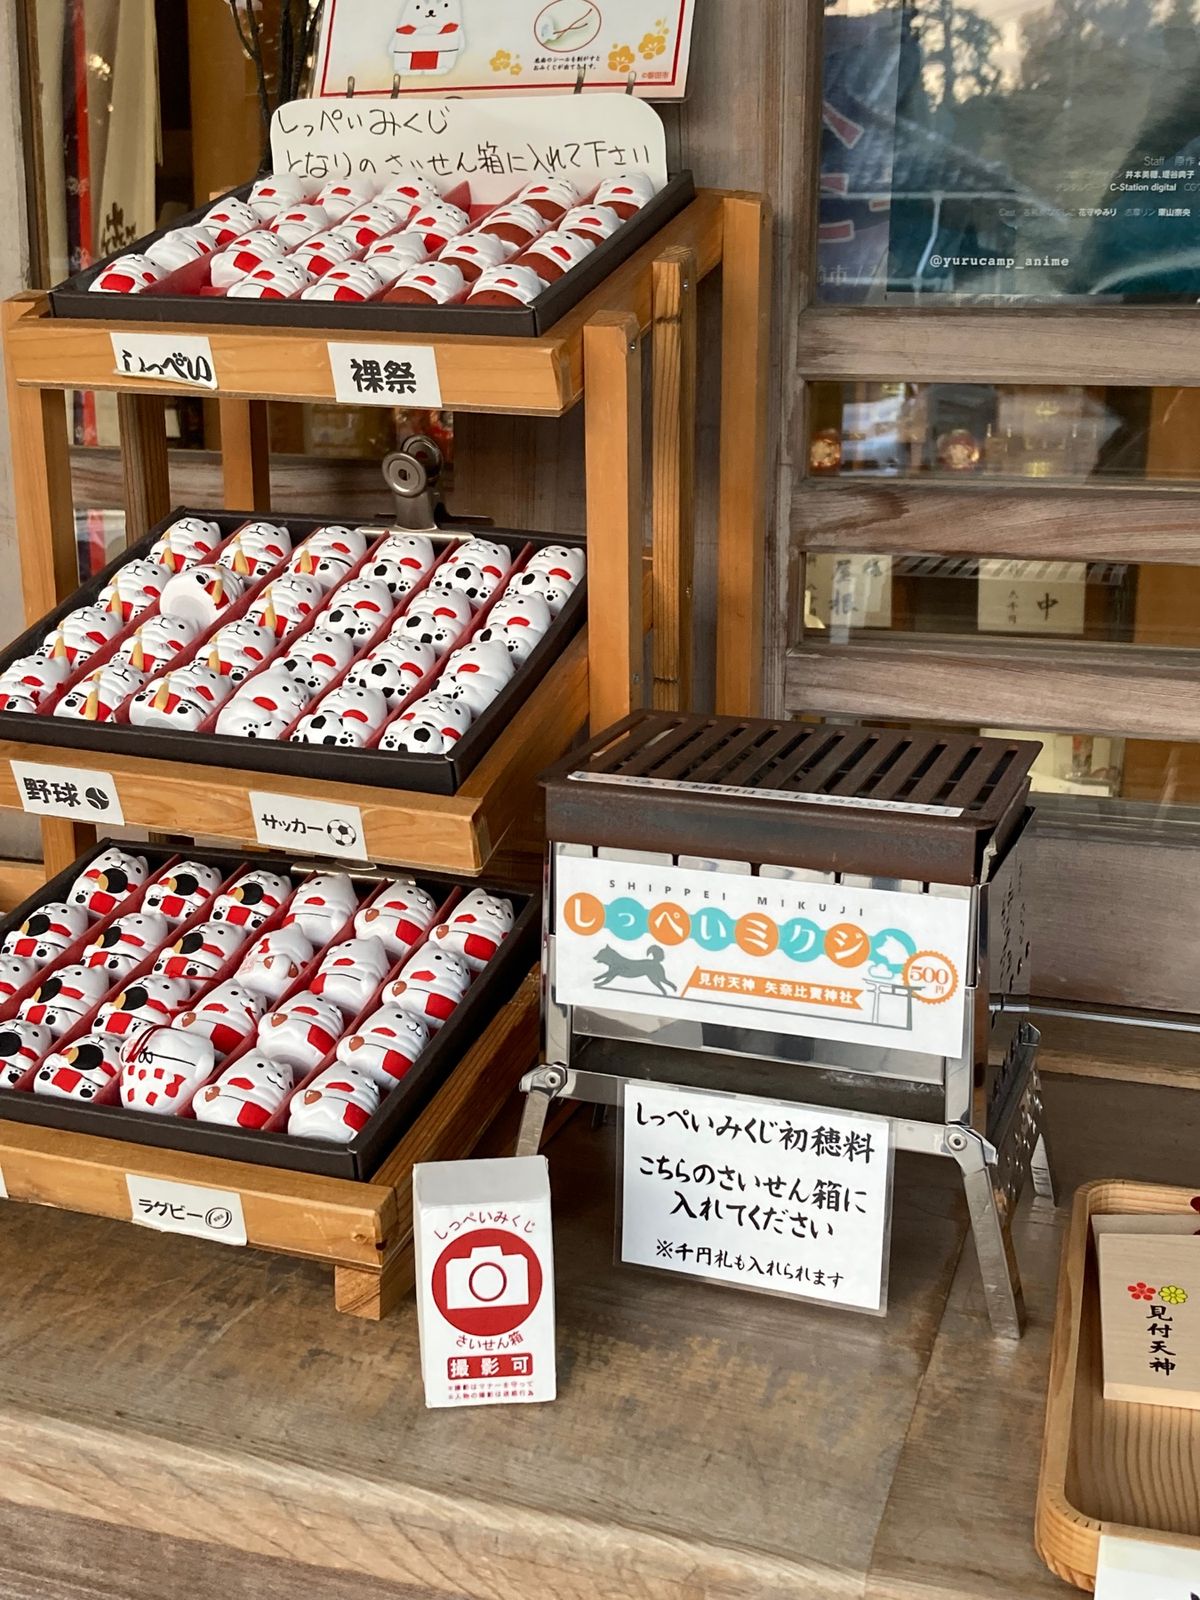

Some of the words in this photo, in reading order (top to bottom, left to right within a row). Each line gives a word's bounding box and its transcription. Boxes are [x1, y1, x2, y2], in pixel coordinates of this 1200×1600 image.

[276, 105, 450, 137] しっぺいみくじ
[1143, 155, 1165, 167] Staff
[1109, 182, 1149, 192] C-Station
[1150, 182, 1177, 193] digital
[929, 254, 1070, 269] @yurucamp_anime
[349, 358, 417, 394] 裸祭
[1036, 592, 1059, 621] 中
[23, 777, 82, 808] 野球
[261, 813, 324, 835] サッカー
[609, 879, 727, 900] SHIPPEI
[757, 896, 864, 917] MIKUJI
[572, 899, 866, 960] しっぺいミクジ
[698, 973, 756, 992] 見付天神
[910, 966, 949, 985] 500
[636, 1102, 875, 1164] しっぺいみくじ初穂料
[639, 1155, 867, 1214] こちらのさいせん箱に
[138, 1198, 203, 1220] ラグビー
[669, 1190, 834, 1239] 入れてください
[434, 1210, 536, 1240] しっぺいみくじ
[455, 1330, 524, 1351] さいせん箱
[1146, 1304, 1176, 1376] 見付天神
[449, 1356, 530, 1378] 撮影可
